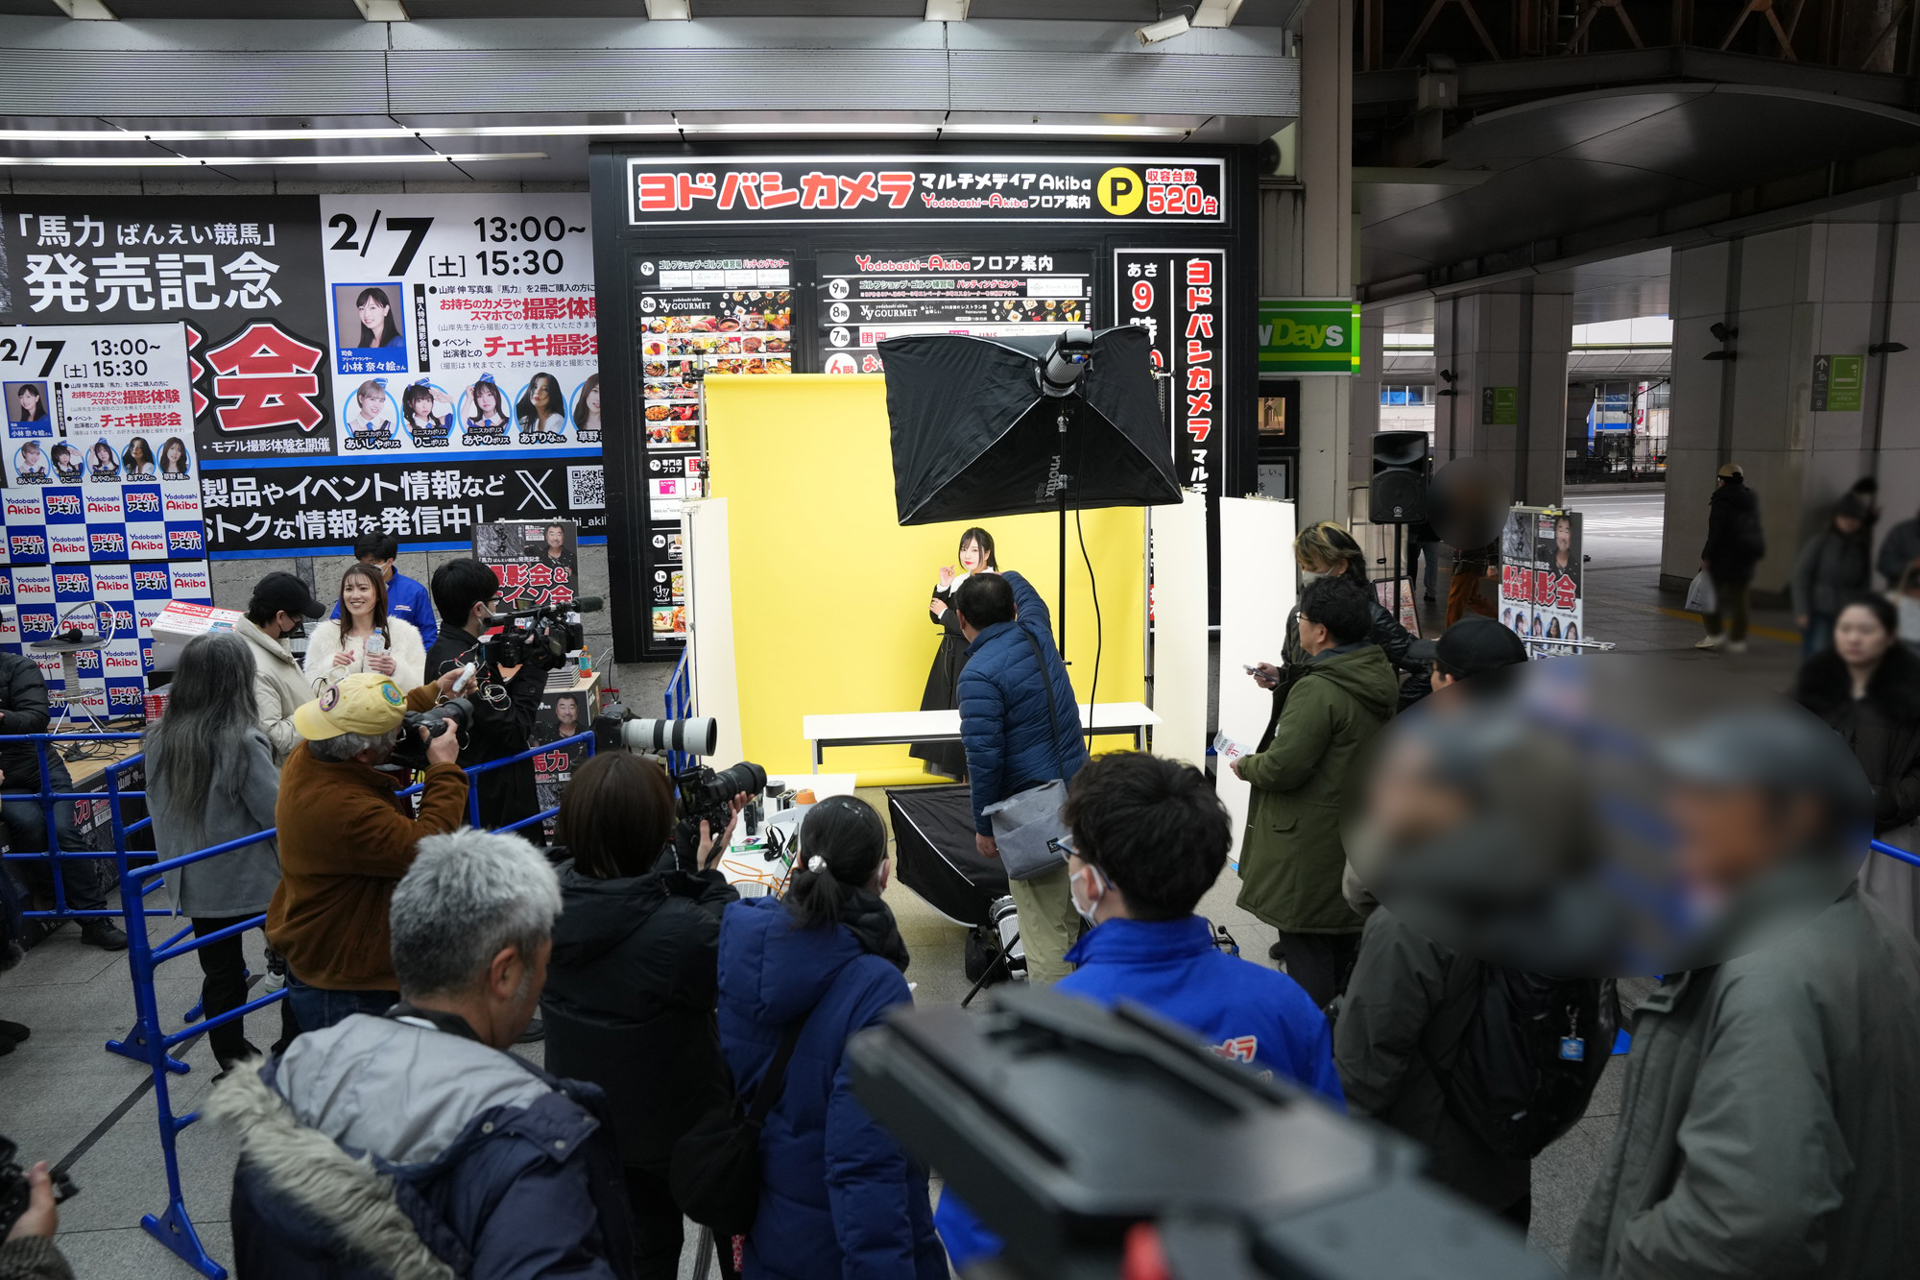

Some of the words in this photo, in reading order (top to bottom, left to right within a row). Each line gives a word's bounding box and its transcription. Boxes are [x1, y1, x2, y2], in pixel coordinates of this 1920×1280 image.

[920, 173, 1036, 190] マルチメディア
[1039, 174, 1091, 190] Akiba
[1146, 169, 1196, 184] 収容台数
[638, 172, 915, 211] ヨドバシカメラ
[1110, 177, 1133, 207] P
[1147, 185, 1218, 215] 520台
[19, 214, 105, 247] 「馬力
[117, 223, 276, 246] ばんえい競馬」
[328, 209, 435, 277] 2/7
[474, 216, 586, 242] 13:00~
[476, 250, 563, 276] 15:30
[1128, 263, 1158, 278] あさ
[23, 252, 283, 312] 発売記念
[439, 285, 456, 295] 山岸
[468, 285, 493, 294] 写真集
[1132, 280, 1154, 312] 9
[440, 299, 521, 311] お持ちのカメラや
[672, 302, 711, 310] GOURMET
[470, 310, 522, 321] スマホでの
[874, 309, 918, 317] GOURMET
[442, 338, 472, 347] イベント
[443, 349, 483, 359] 出演者との
[1185, 258, 1213, 442] ヨドバシカメラ
[1, 336, 66, 377] 2/7
[91, 339, 161, 356] 13:00~
[93, 360, 148, 377] 15:30
[342, 362, 363, 372] 小林
[123, 389, 180, 404] 撮影体験
[100, 412, 182, 427] チェキ撮影会
[412, 437, 448, 447] りこポリス
[463, 434, 510, 446] あやのポリス
[202, 470, 505, 509] 製品やイベント情報など
[47, 495, 80, 504] ヨドバシ
[126, 493, 158, 502] ヨドバシ
[7, 505, 41, 515] Akiba
[48, 502, 81, 515] アキバ
[87, 502, 120, 513] Akiba
[127, 501, 159, 513] アキバ
[166, 500, 199, 511] Akiba
[11, 535, 44, 545] ヨドバシ
[91, 533, 123, 543] ヨドバシ
[169, 531, 201, 540] ヨドバシ
[13, 543, 45, 555] アキバ
[53, 543, 85, 553] Akiba
[92, 541, 124, 552] アキバ
[131, 540, 164, 551] Akiba
[170, 539, 202, 550] アキバ
[56, 574, 88, 583] ヨドバシ
[134, 571, 166, 581] ヨドバシ
[17, 583, 51, 594] Akiba
[57, 581, 90, 593] アキバ
[96, 581, 129, 591] Akiba
[135, 579, 167, 590] アキバ
[174, 578, 206, 589] Akiba
[106, 657, 138, 667] Akiba
[82, 698, 104, 706] kiba
